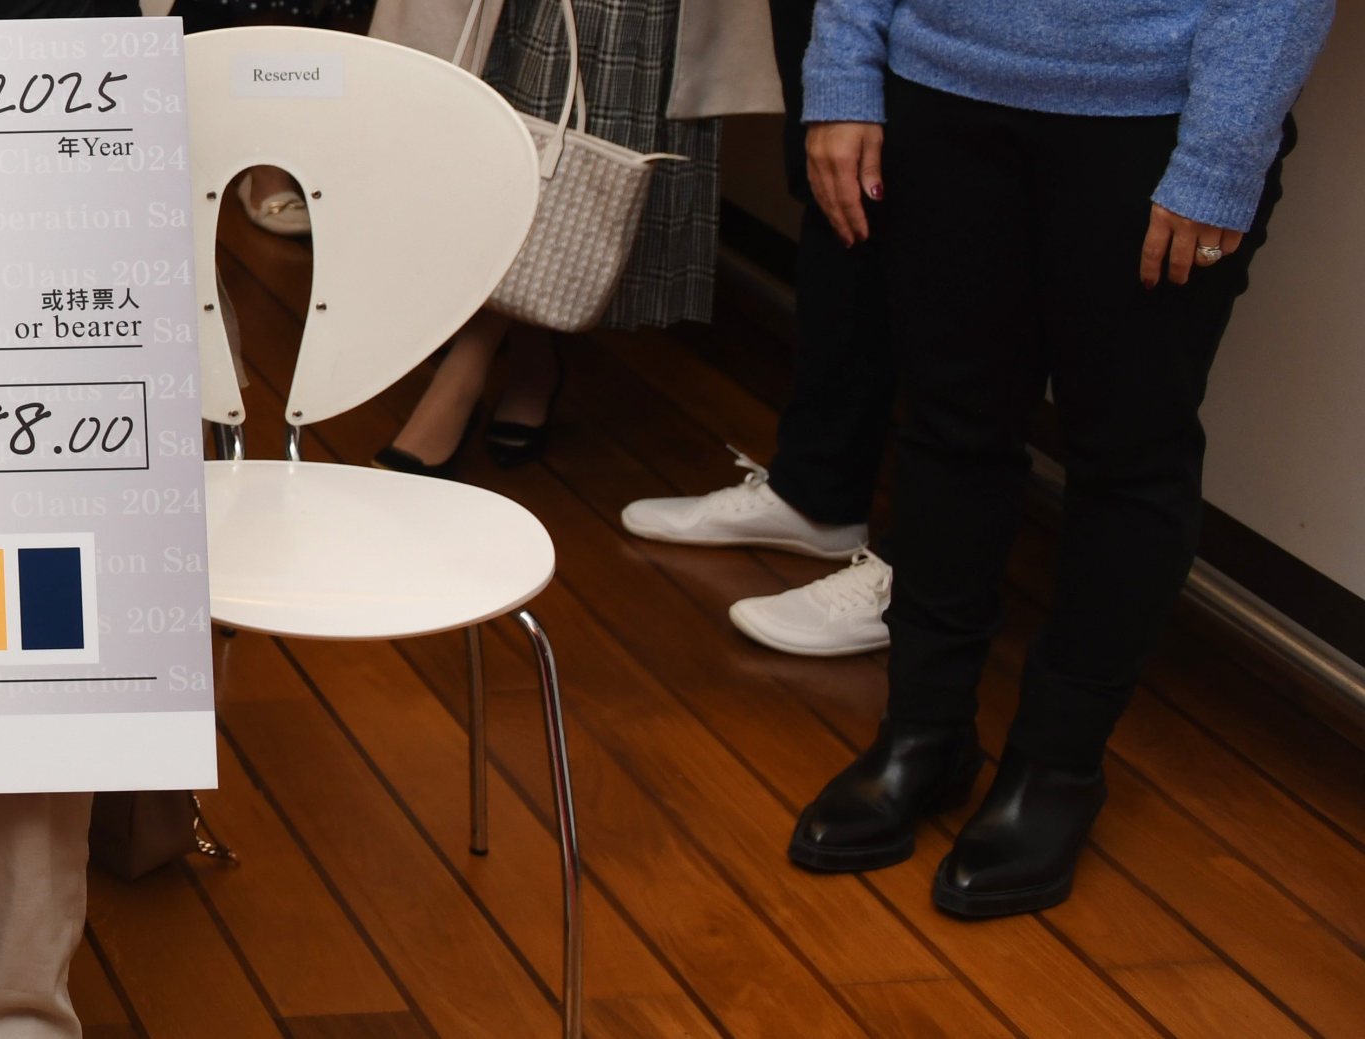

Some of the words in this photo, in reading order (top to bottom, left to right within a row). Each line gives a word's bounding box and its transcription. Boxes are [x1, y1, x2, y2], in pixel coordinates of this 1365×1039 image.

[101, 32, 182, 60] 2024
[253, 67, 320, 82] Reserved
[111, 259, 193, 287] 2024
[42, 288, 139, 311] 或持票人
[15, 323, 42, 338] or
[53, 315, 141, 338] bearer
[121, 488, 204, 517] 2024
